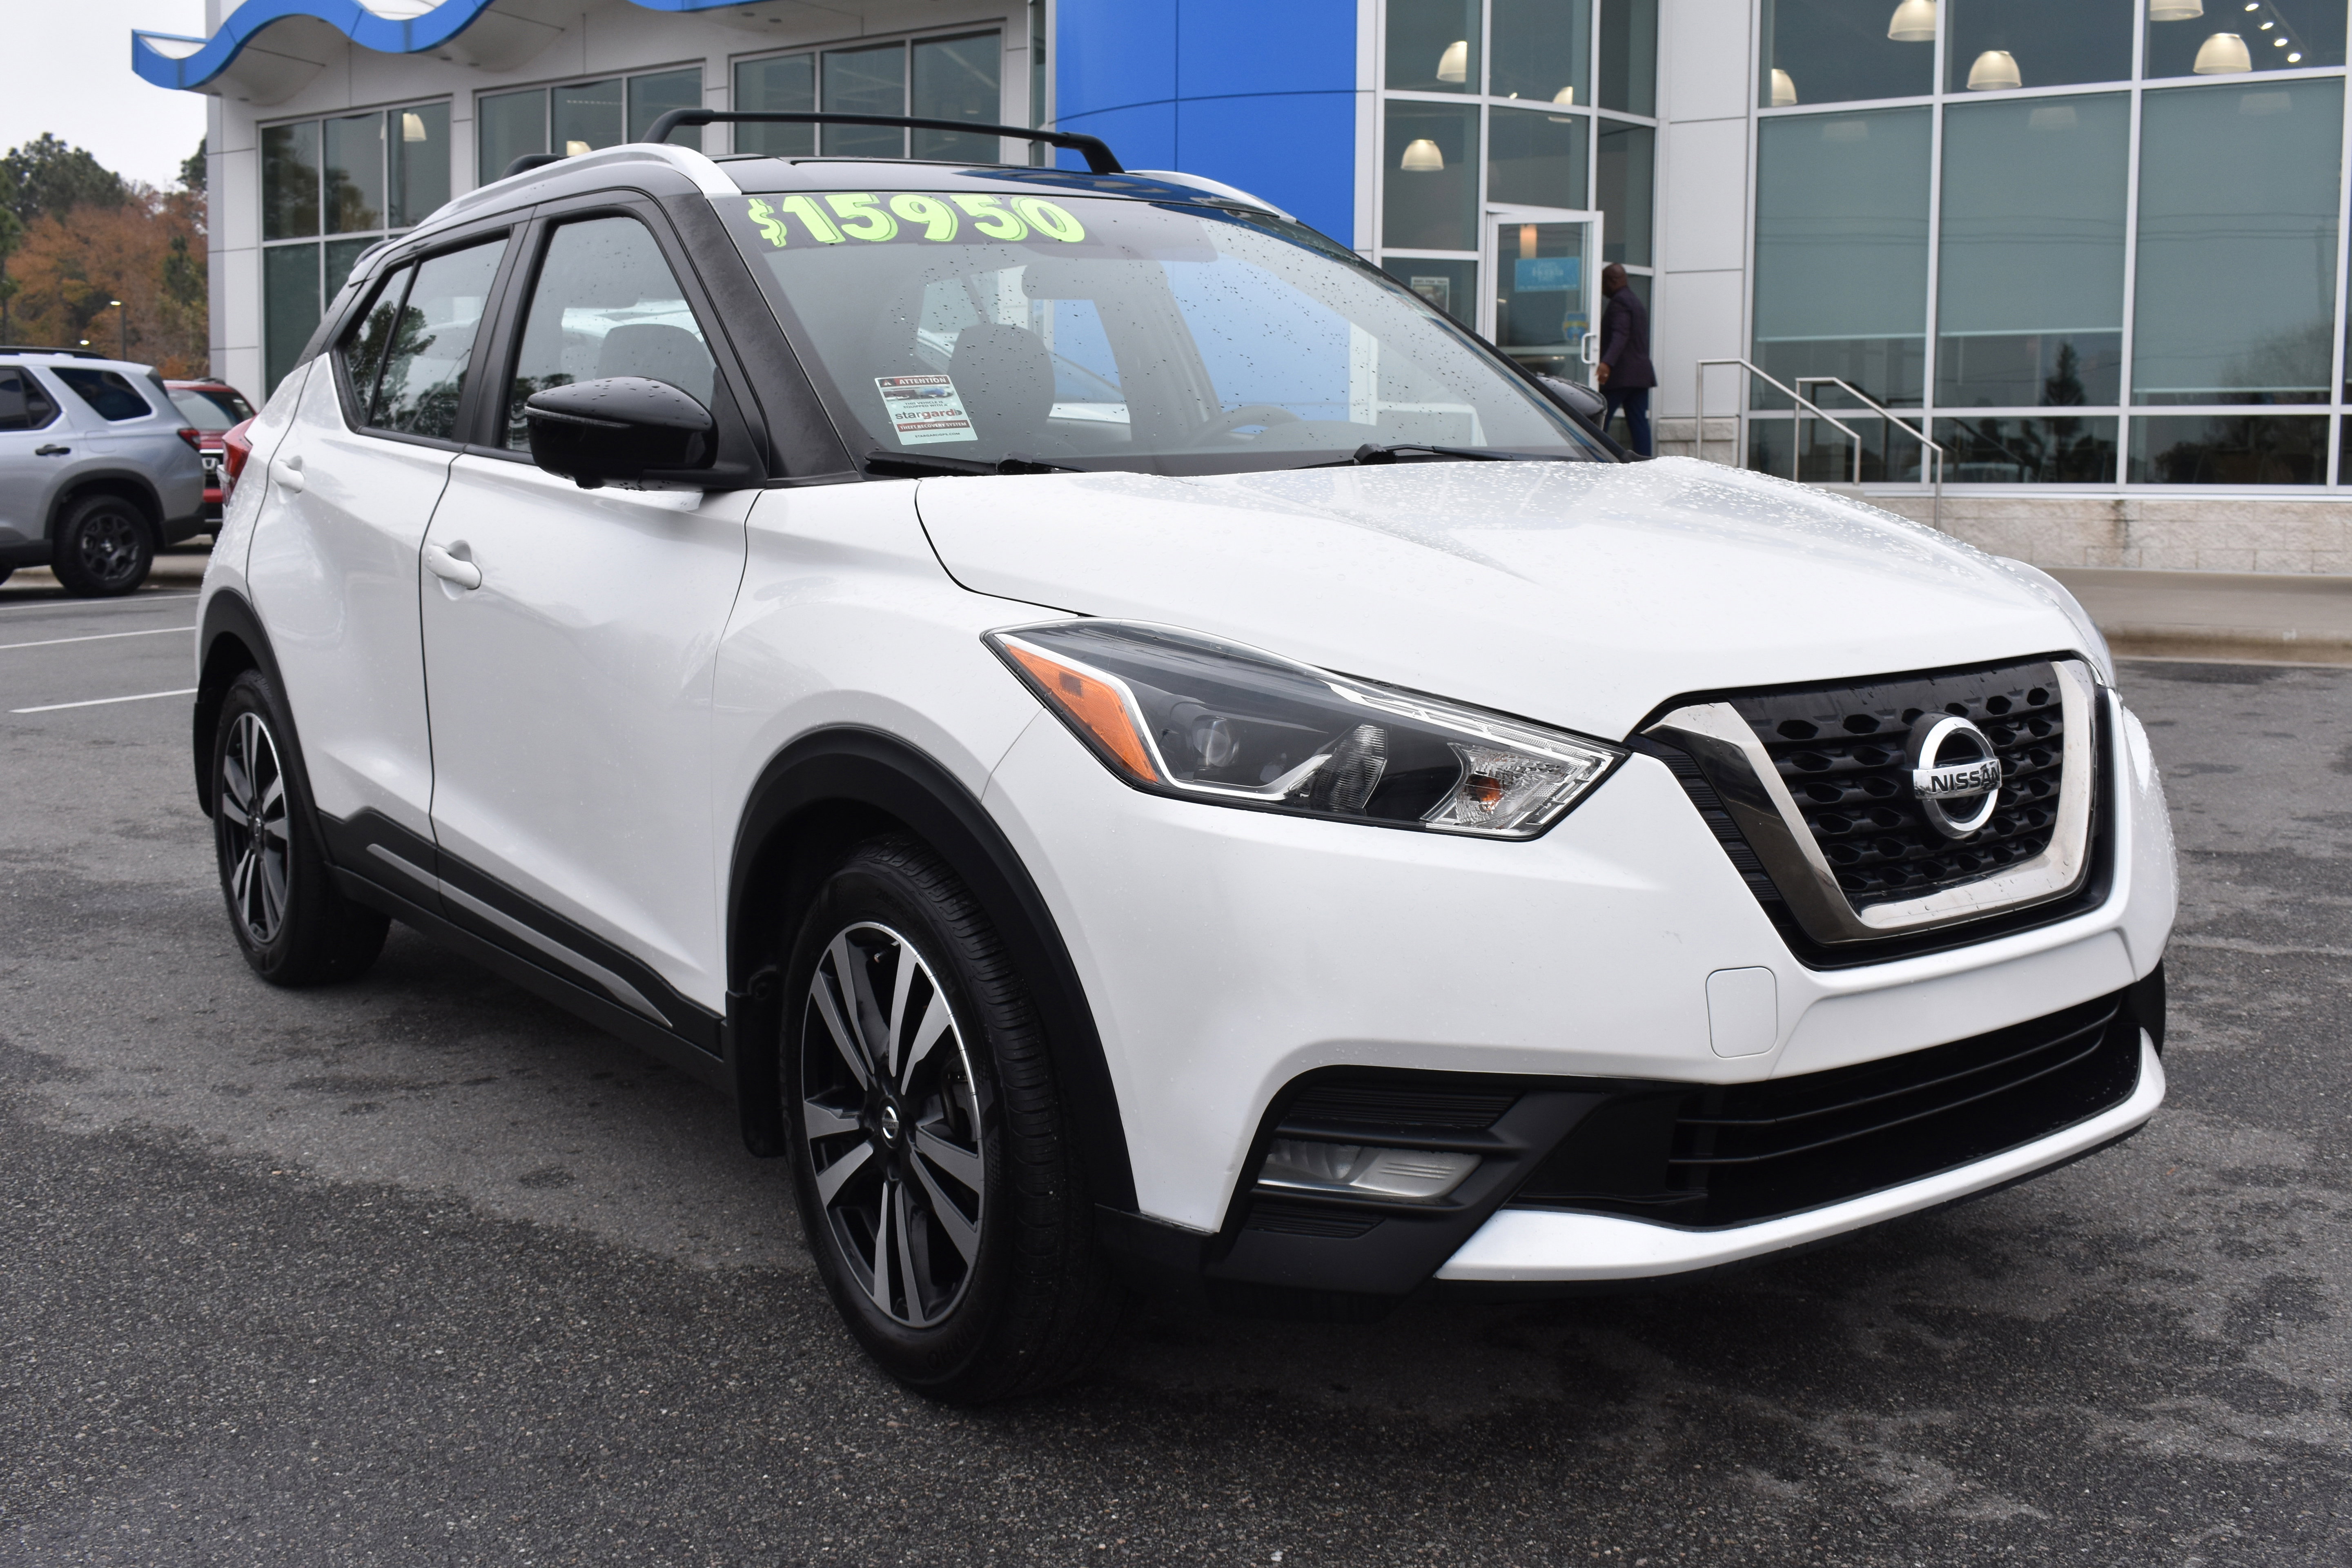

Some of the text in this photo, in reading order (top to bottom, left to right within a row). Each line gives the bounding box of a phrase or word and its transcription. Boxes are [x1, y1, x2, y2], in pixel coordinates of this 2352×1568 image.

[748, 194, 1085, 247] $15950
[895, 409, 955, 419] stargard
[1931, 767, 2000, 792] NISSAN
